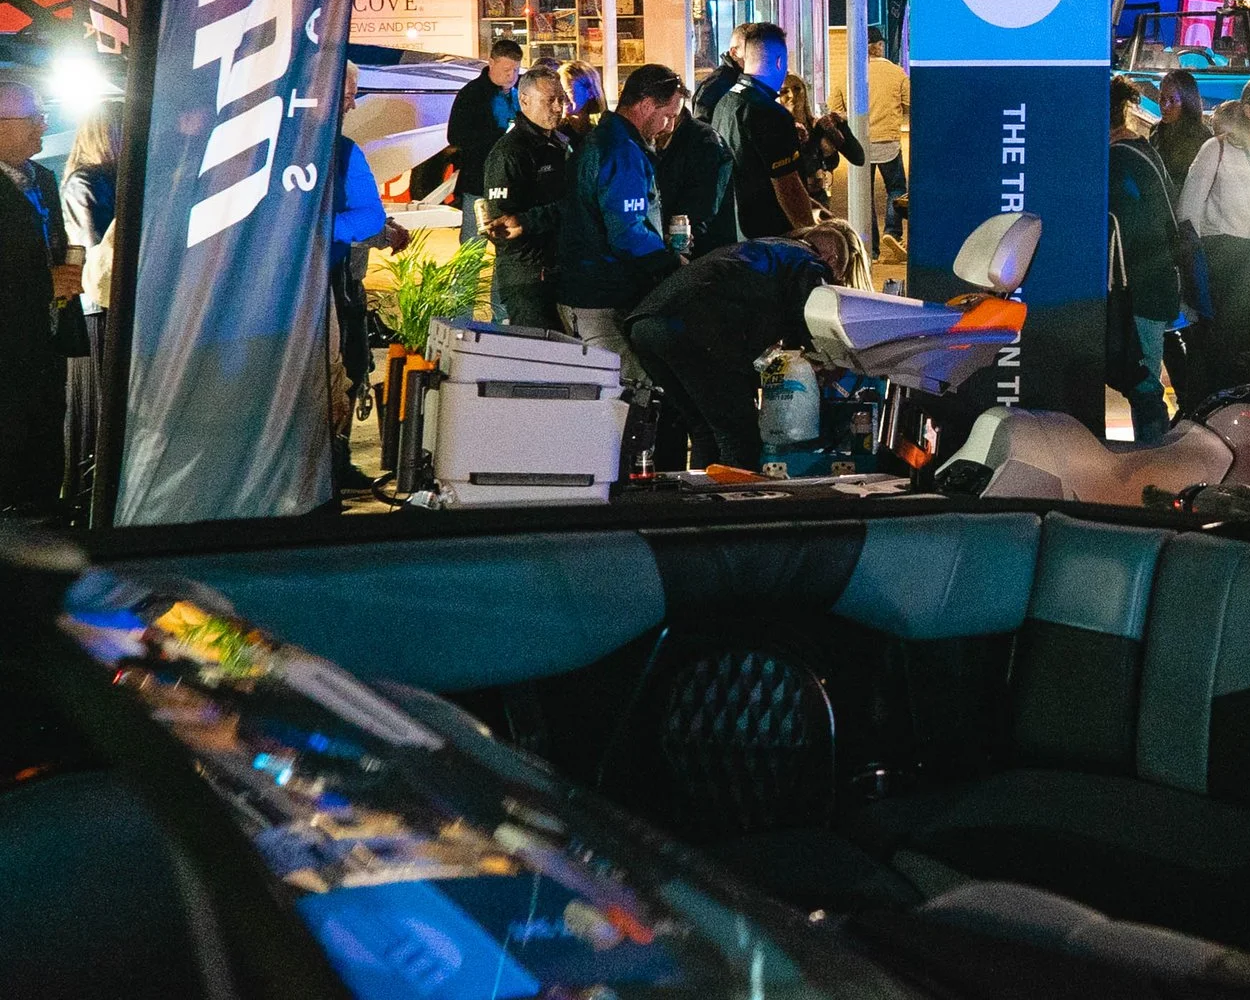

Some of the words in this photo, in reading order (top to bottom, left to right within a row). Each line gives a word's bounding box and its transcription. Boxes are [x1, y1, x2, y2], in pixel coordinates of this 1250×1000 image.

[350, 22, 376, 33] EWS
[379, 22, 403, 32] AND
[407, 21, 438, 32] POST
[1002, 103, 1026, 165] THE
[488, 187, 509, 200] HH
[623, 197, 645, 213] HH
